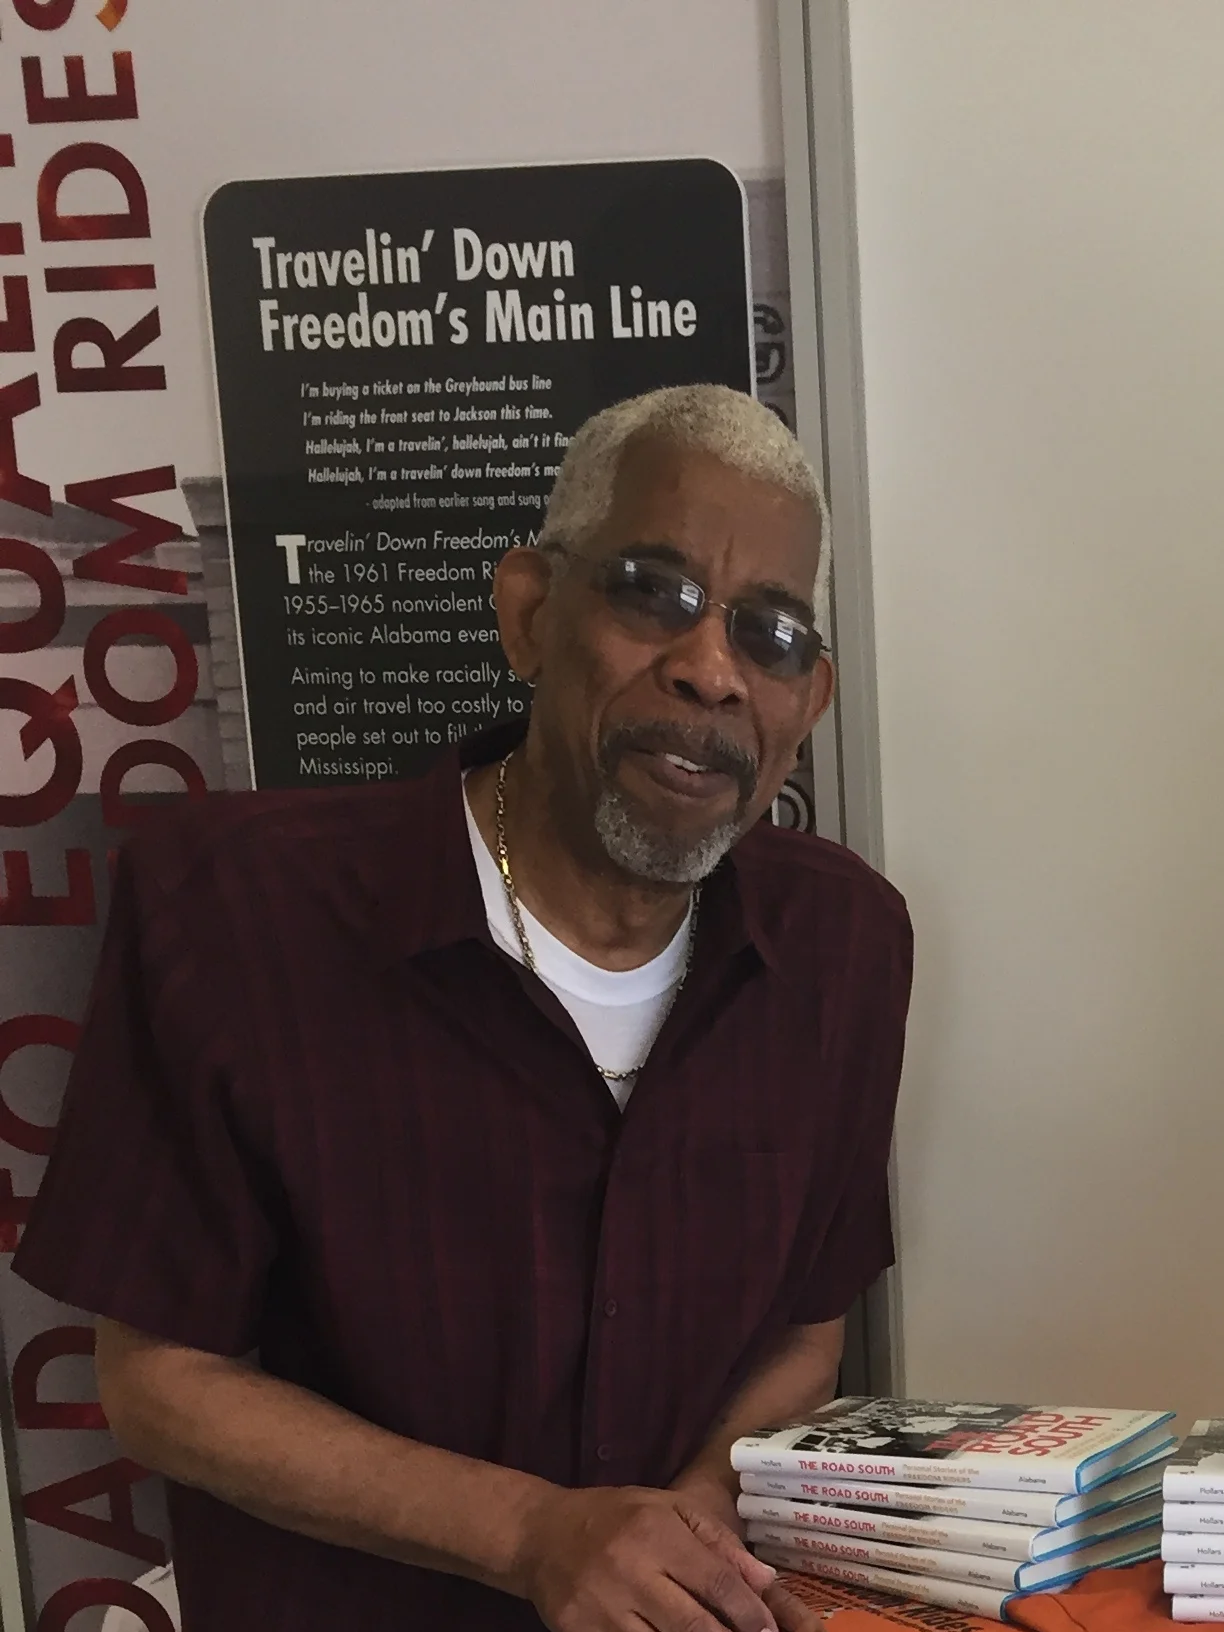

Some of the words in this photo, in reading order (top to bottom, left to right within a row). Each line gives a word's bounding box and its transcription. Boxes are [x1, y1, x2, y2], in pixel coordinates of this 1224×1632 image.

[253, 228, 434, 290] Travelin’
[454, 227, 575, 283] Down
[260, 292, 469, 352] Freedom’s
[486, 289, 595, 344] Main
[611, 285, 697, 340] Line
[301, 382, 319, 398] I’m
[323, 381, 359, 401] buying
[362, 385, 370, 396] a
[373, 378, 403, 395] ticket
[407, 382, 420, 394] on
[424, 377, 442, 393] the
[445, 376, 506, 397] Greyhound
[509, 376, 529, 391] bus
[532, 375, 552, 391] line
[303, 411, 322, 427] I’m
[325, 408, 356, 429] riding
[359, 408, 377, 425] the
[381, 407, 408, 424] front
[412, 408, 435, 423] seat
[438, 407, 450, 422] to
[453, 405, 497, 422] Jackson
[500, 404, 521, 420] this
[525, 404, 553, 420] time.
[306, 438, 362, 458] Hallelujah,
[366, 438, 385, 453] I’m
[388, 442, 395, 453] a
[452, 433, 509, 453] hallelujah,
[512, 433, 540, 449] ain’t
[542, 433, 551, 447] it
[308, 466, 364, 486] Hallelujah,
[368, 466, 387, 481] I’m
[390, 470, 398, 481] a
[401, 464, 447, 480] travelin’
[451, 464, 482, 479] down
[485, 461, 540, 480] freedom’s
[372, 494, 411, 512] adapted
[412, 494, 436, 509] from
[438, 492, 470, 508] earlier
[472, 495, 496, 511] song
[497, 491, 516, 507] and
[518, 493, 542, 510] sung
[376, 532, 427, 551] Down
[433, 529, 521, 551] Freedom’s
[308, 567, 335, 583] the
[344, 563, 390, 583] 1961
[398, 562, 475, 583] Freedom
[392, 592, 483, 613] nonviolent
[287, 629, 305, 646] its
[312, 627, 362, 645] iconic
[370, 624, 451, 644] Alabama
[458, 629, 499, 643] even
[291, 667, 353, 690] Aiming
[359, 670, 376, 685] to
[383, 664, 429, 684] make
[436, 661, 500, 687] racially
[293, 698, 327, 716] and
[334, 696, 357, 714] air
[363, 695, 411, 715] travel
[418, 697, 445, 714] too
[452, 694, 500, 718] costly
[507, 696, 524, 713] to
[297, 724, 357, 750] people
[363, 727, 386, 745] set
[392, 728, 419, 745] out
[424, 727, 441, 744] to
[447, 723, 468, 743] fill
[300, 756, 400, 780] Mississippi.
[1008, 1415, 1112, 1457] SOUTH
[798, 1460, 818, 1471] THE
[822, 1462, 855, 1473] ROAD
[858, 1465, 896, 1475] SOUTH
[801, 1484, 819, 1495] THE
[821, 1486, 852, 1499] ROAD
[855, 1490, 889, 1503] SOUTH
[813, 1514, 842, 1528] ROAD
[844, 1519, 876, 1532] SOUTH
